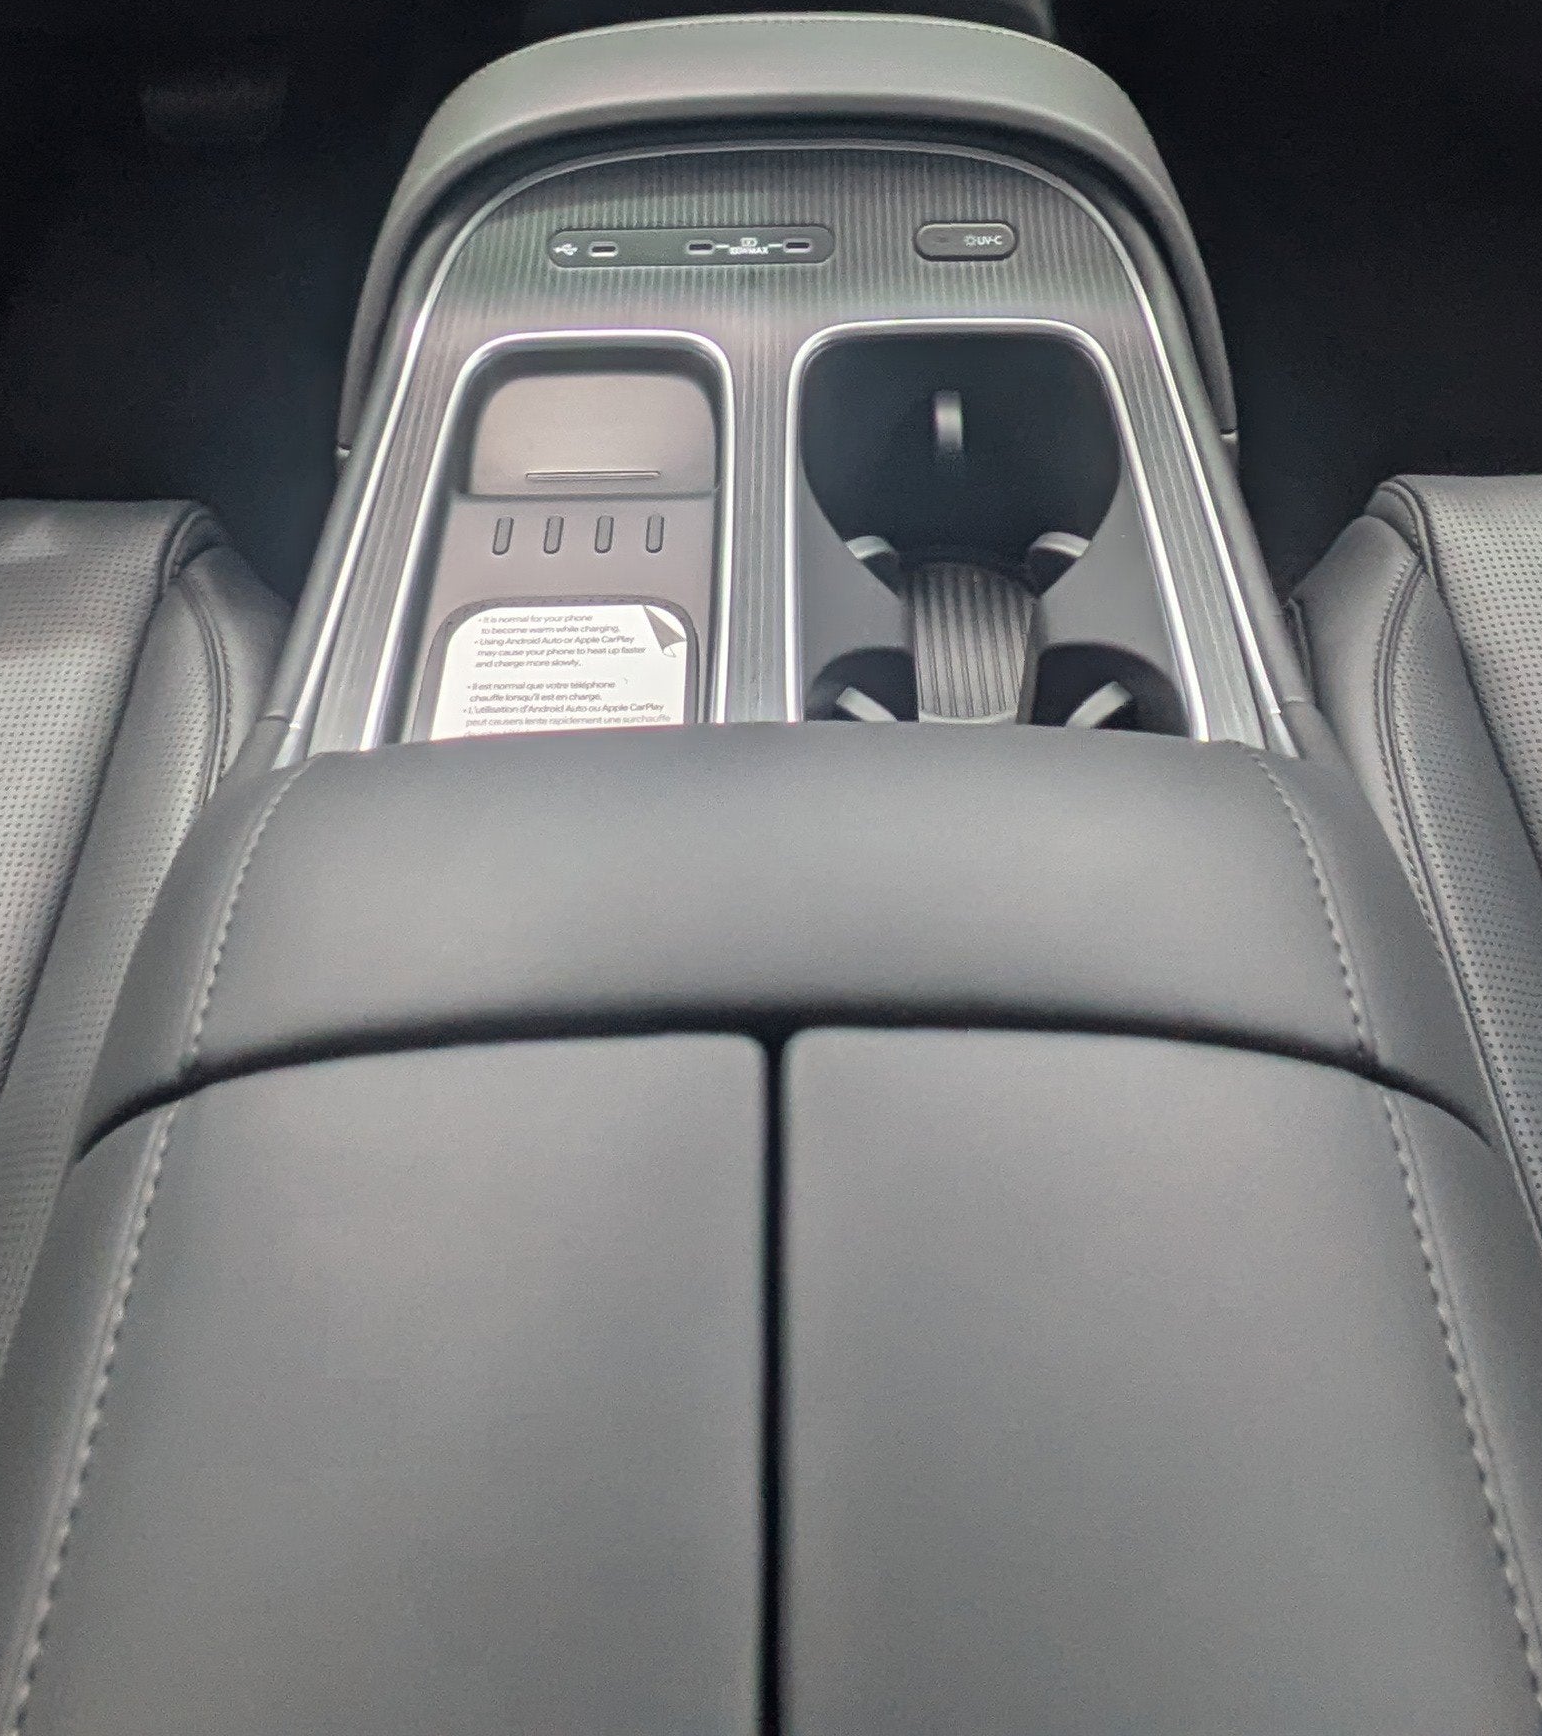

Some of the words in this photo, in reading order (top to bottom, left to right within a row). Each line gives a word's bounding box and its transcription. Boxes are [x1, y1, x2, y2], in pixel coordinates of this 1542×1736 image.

[977, 235, 1003, 246] UV-C
[565, 614, 593, 624] phone
[505, 637, 541, 645] Android
[575, 636, 601, 646] Apple
[601, 635, 635, 645] CarPlay
[546, 647, 575, 657] phone
[602, 703, 629, 713] Apple
[629, 702, 665, 712] CarPlay
